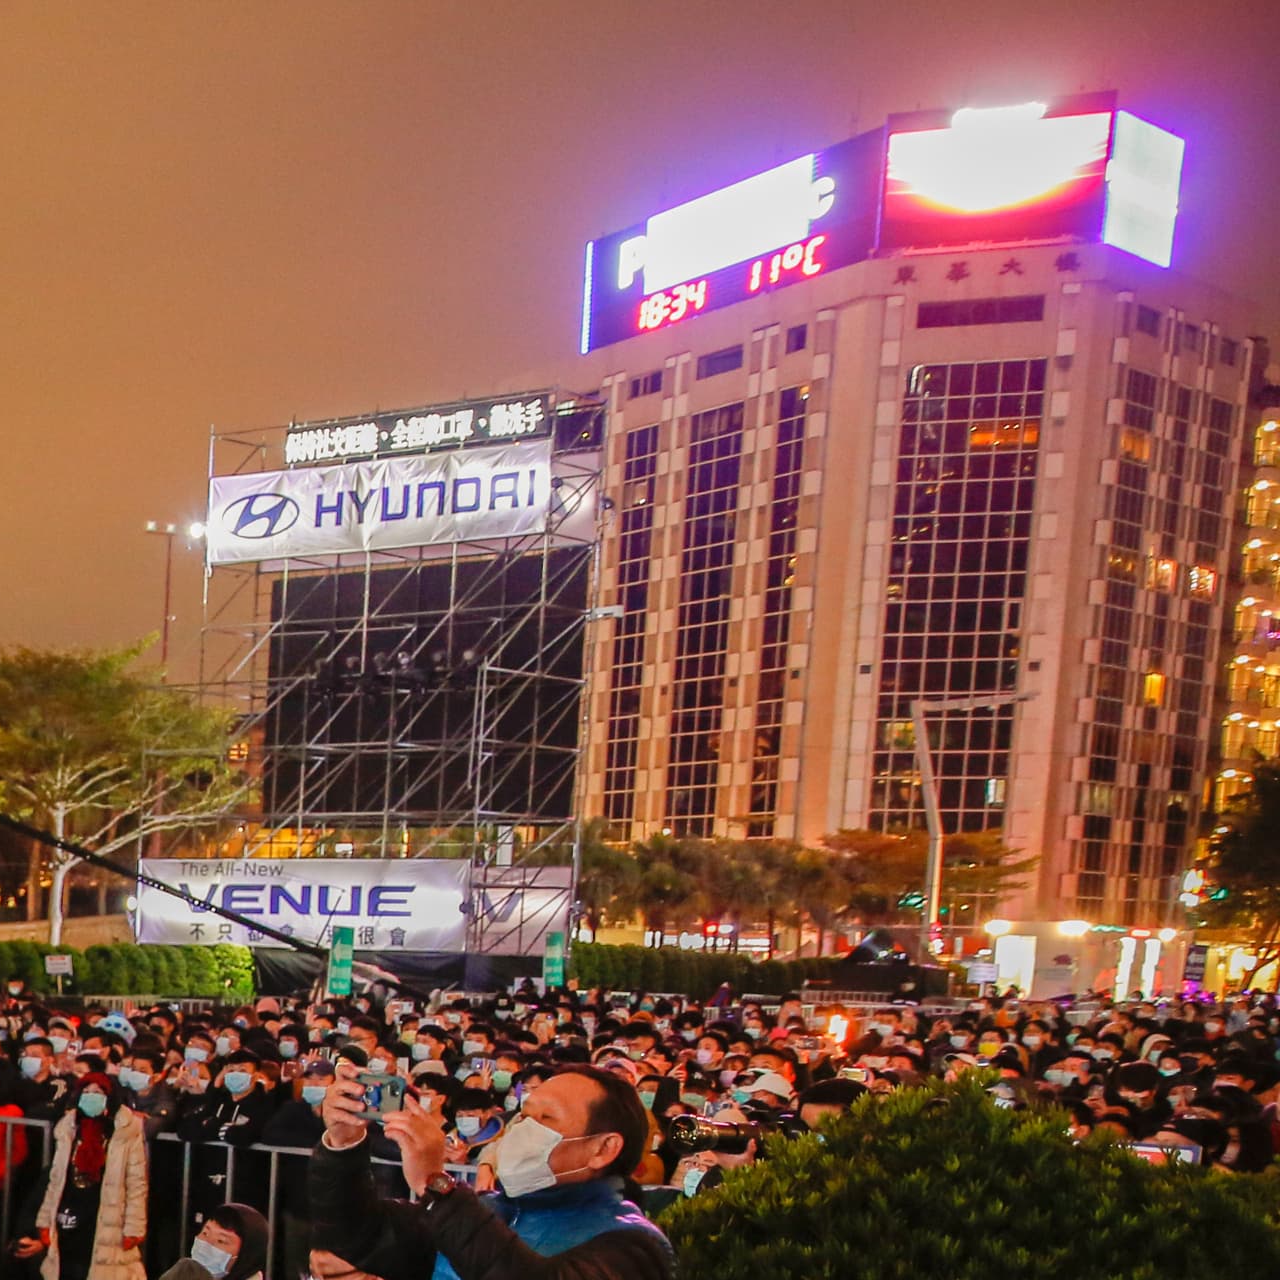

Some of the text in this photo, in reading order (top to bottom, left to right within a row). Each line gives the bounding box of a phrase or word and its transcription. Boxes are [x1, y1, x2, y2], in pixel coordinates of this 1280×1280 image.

[639, 280, 707, 329] 18:34
[313, 469, 536, 528] HYUNDAI
[180, 862, 284, 877] The All-New
[178, 883, 417, 917] VENUE
